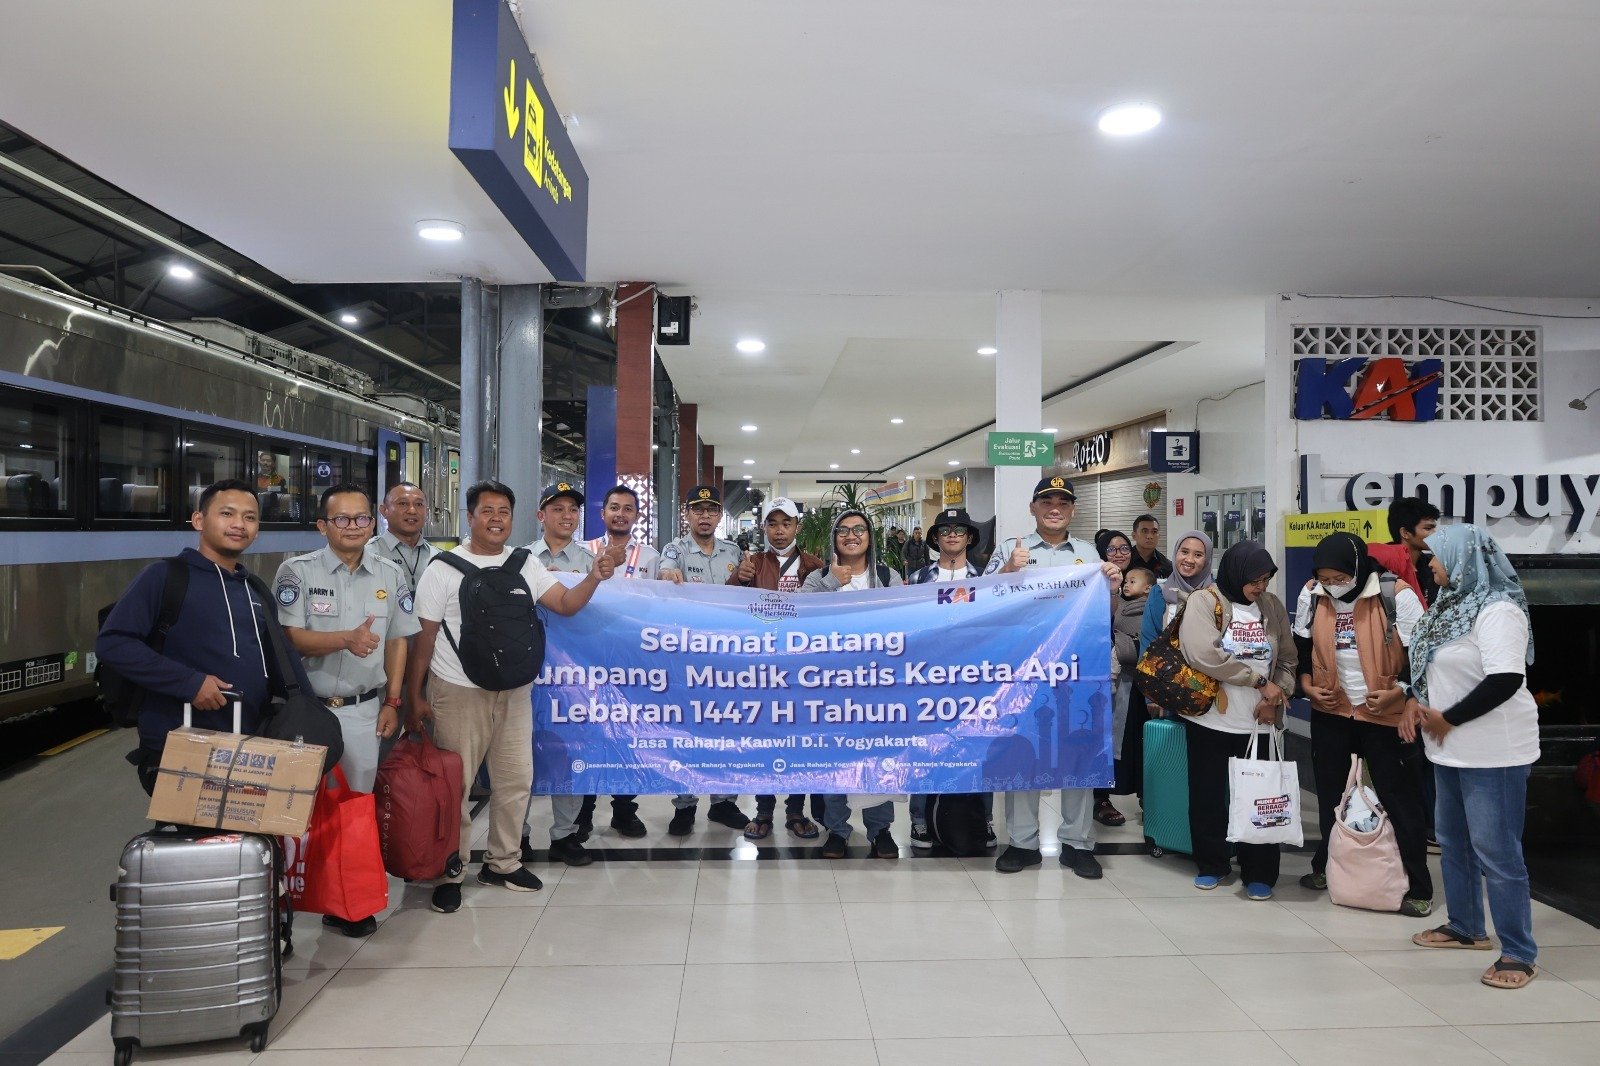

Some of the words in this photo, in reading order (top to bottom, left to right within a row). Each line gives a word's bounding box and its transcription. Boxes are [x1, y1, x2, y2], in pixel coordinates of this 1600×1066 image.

[1294, 357, 1444, 422] KAI
[1289, 521, 1306, 531] Keluar
[1306, 520, 1315, 530] KA
[1315, 520, 1331, 530] Antar
[1331, 519, 1346, 530] Kota
[309, 587, 328, 596] HARRY
[330, 589, 334, 597] H
[1009, 583, 1035, 593] JASA
[1037, 579, 1088, 590] RAHARJA
[938, 586, 976, 605] KAI
[748, 602, 796, 614] Nyaman
[640, 627, 777, 653] Selamat
[786, 631, 905, 657] Datang
[533, 664, 668, 692] umpang
[686, 664, 789, 688] Mudik
[797, 661, 896, 688] Gratis
[905, 659, 1014, 685] Kereta
[1021, 653, 1079, 688] Api
[551, 698, 682, 724] Lebaran
[689, 700, 762, 724] 1447
[771, 700, 794, 724] H
[804, 698, 907, 723] Tahun
[916, 695, 998, 722] 2026
[628, 736, 668, 750] Jasa
[672, 737, 736, 751] Raharja
[740, 736, 796, 750] Kanwil
[833, 734, 929, 750] Yogyakarta
[701, 761, 727, 769] Raharja
[728, 761, 765, 769] Yogyakarta
[939, 761, 978, 769] Yogyakarta
[382, 784, 392, 861] GIORDAN
